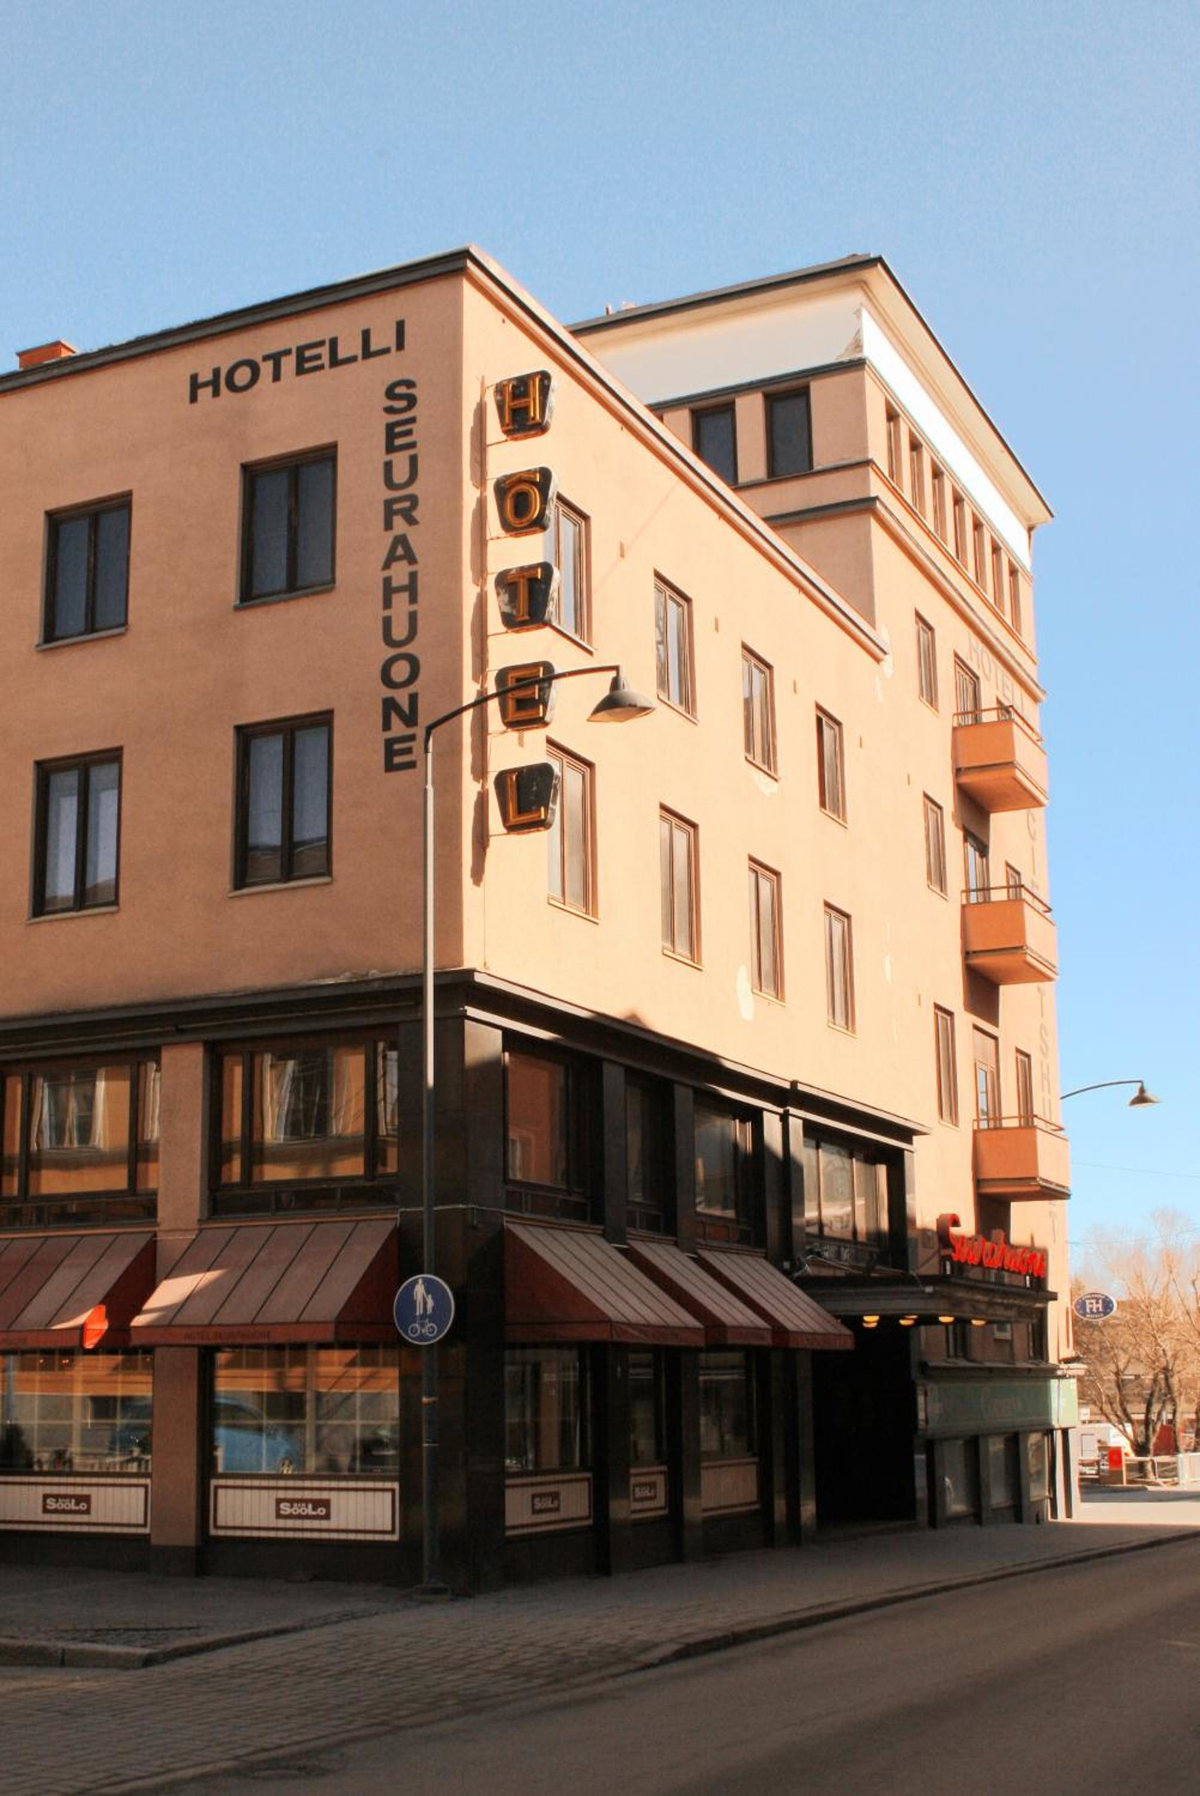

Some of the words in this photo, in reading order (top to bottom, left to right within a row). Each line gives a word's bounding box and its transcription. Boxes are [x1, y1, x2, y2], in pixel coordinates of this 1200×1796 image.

[189, 319, 406, 405] HOTELLI
[380, 378, 421, 774] SEURAHUONE
[500, 371, 548, 828] HOTEL
